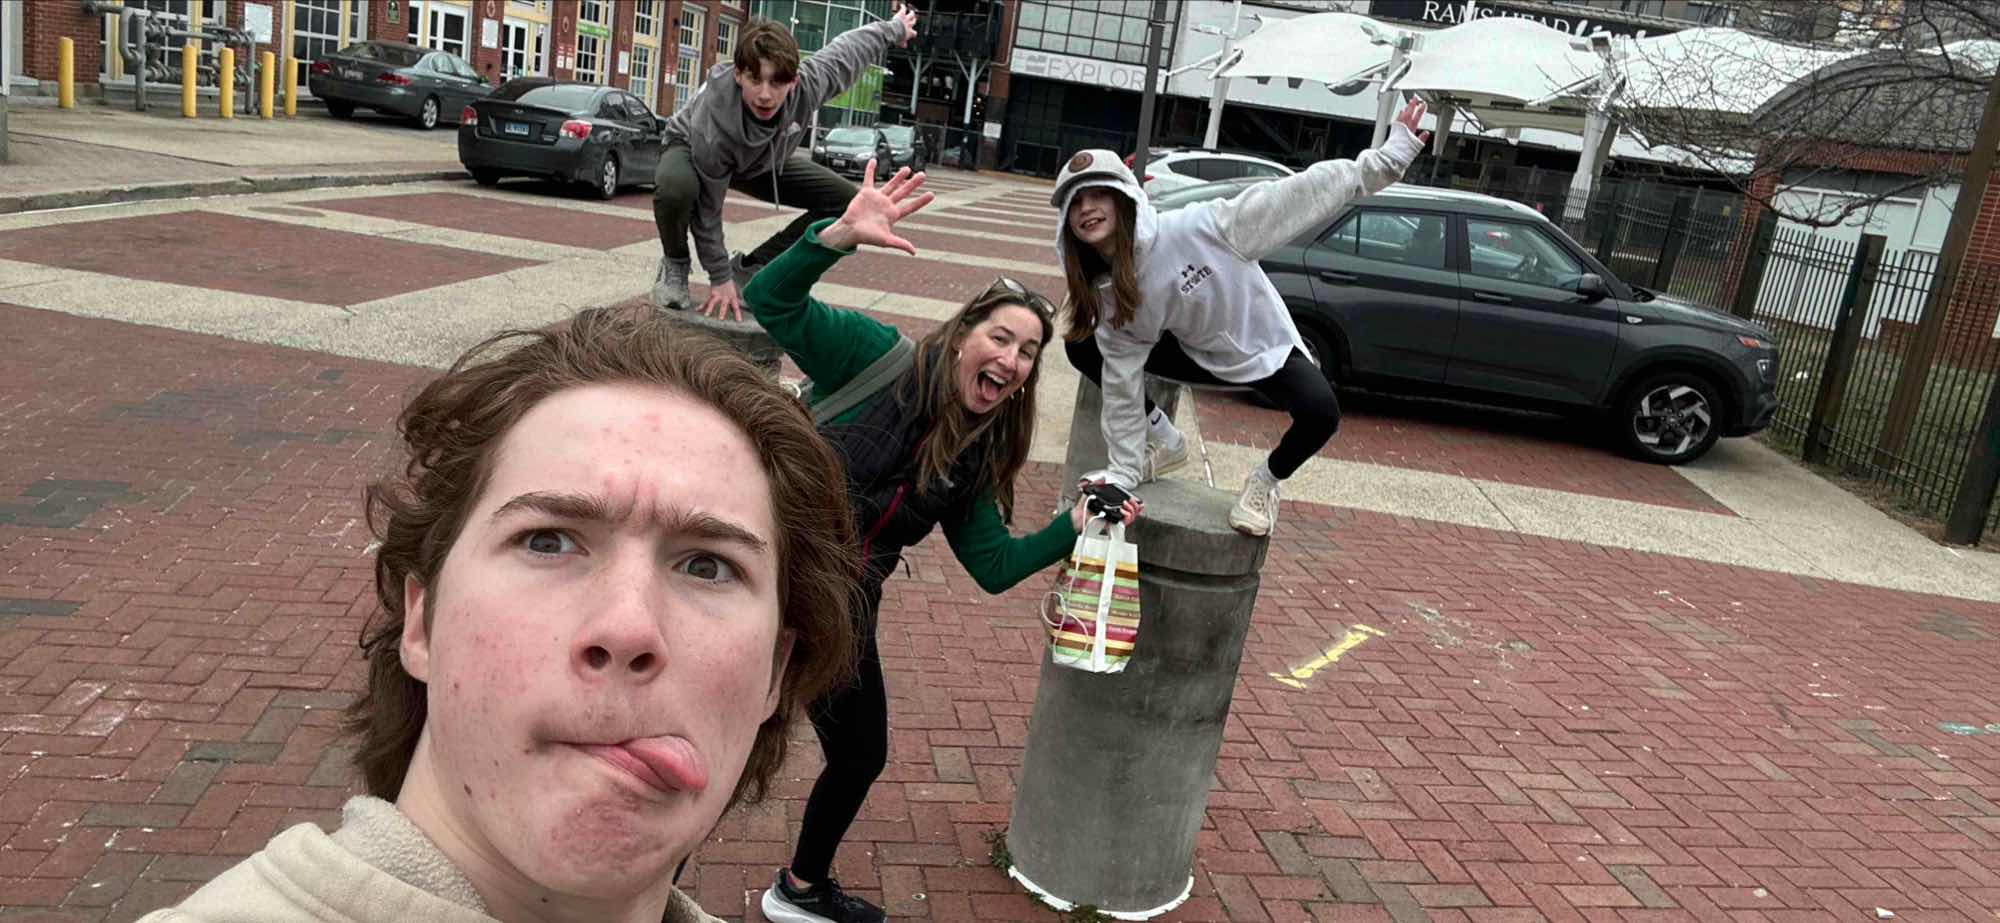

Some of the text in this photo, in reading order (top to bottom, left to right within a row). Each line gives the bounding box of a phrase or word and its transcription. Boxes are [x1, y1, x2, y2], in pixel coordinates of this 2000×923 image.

[1422, 1, 1493, 24] RAMS
[1501, 11, 1570, 34] AD
[1047, 58, 1162, 91] EXPLOR
